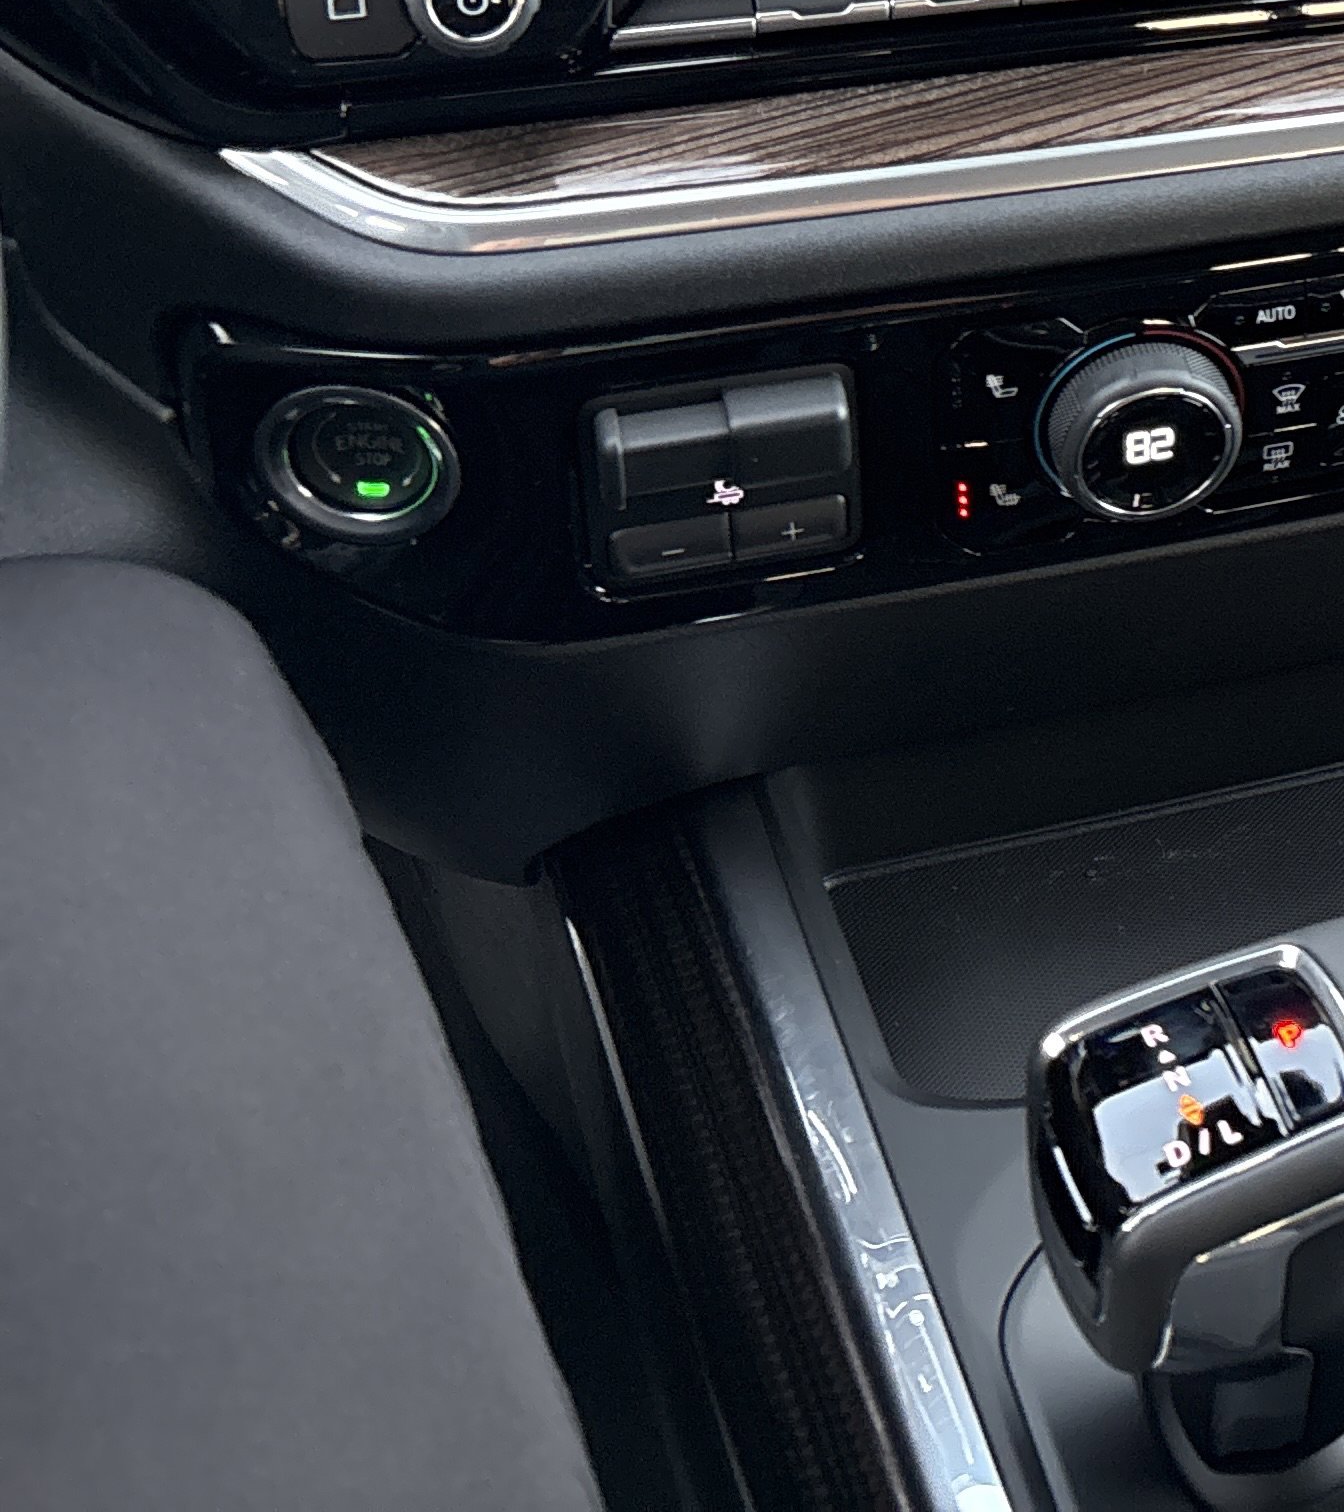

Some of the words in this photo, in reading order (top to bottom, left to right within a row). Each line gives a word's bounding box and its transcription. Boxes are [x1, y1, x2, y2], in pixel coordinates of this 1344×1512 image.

[1255, 305, 1297, 324] AUTO
[1276, 403, 1301, 415] MAX
[1126, 426, 1175, 465] 82
[1140, 1023, 1168, 1048] R
[1275, 1021, 1302, 1049] P
[1162, 1065, 1192, 1092] N
